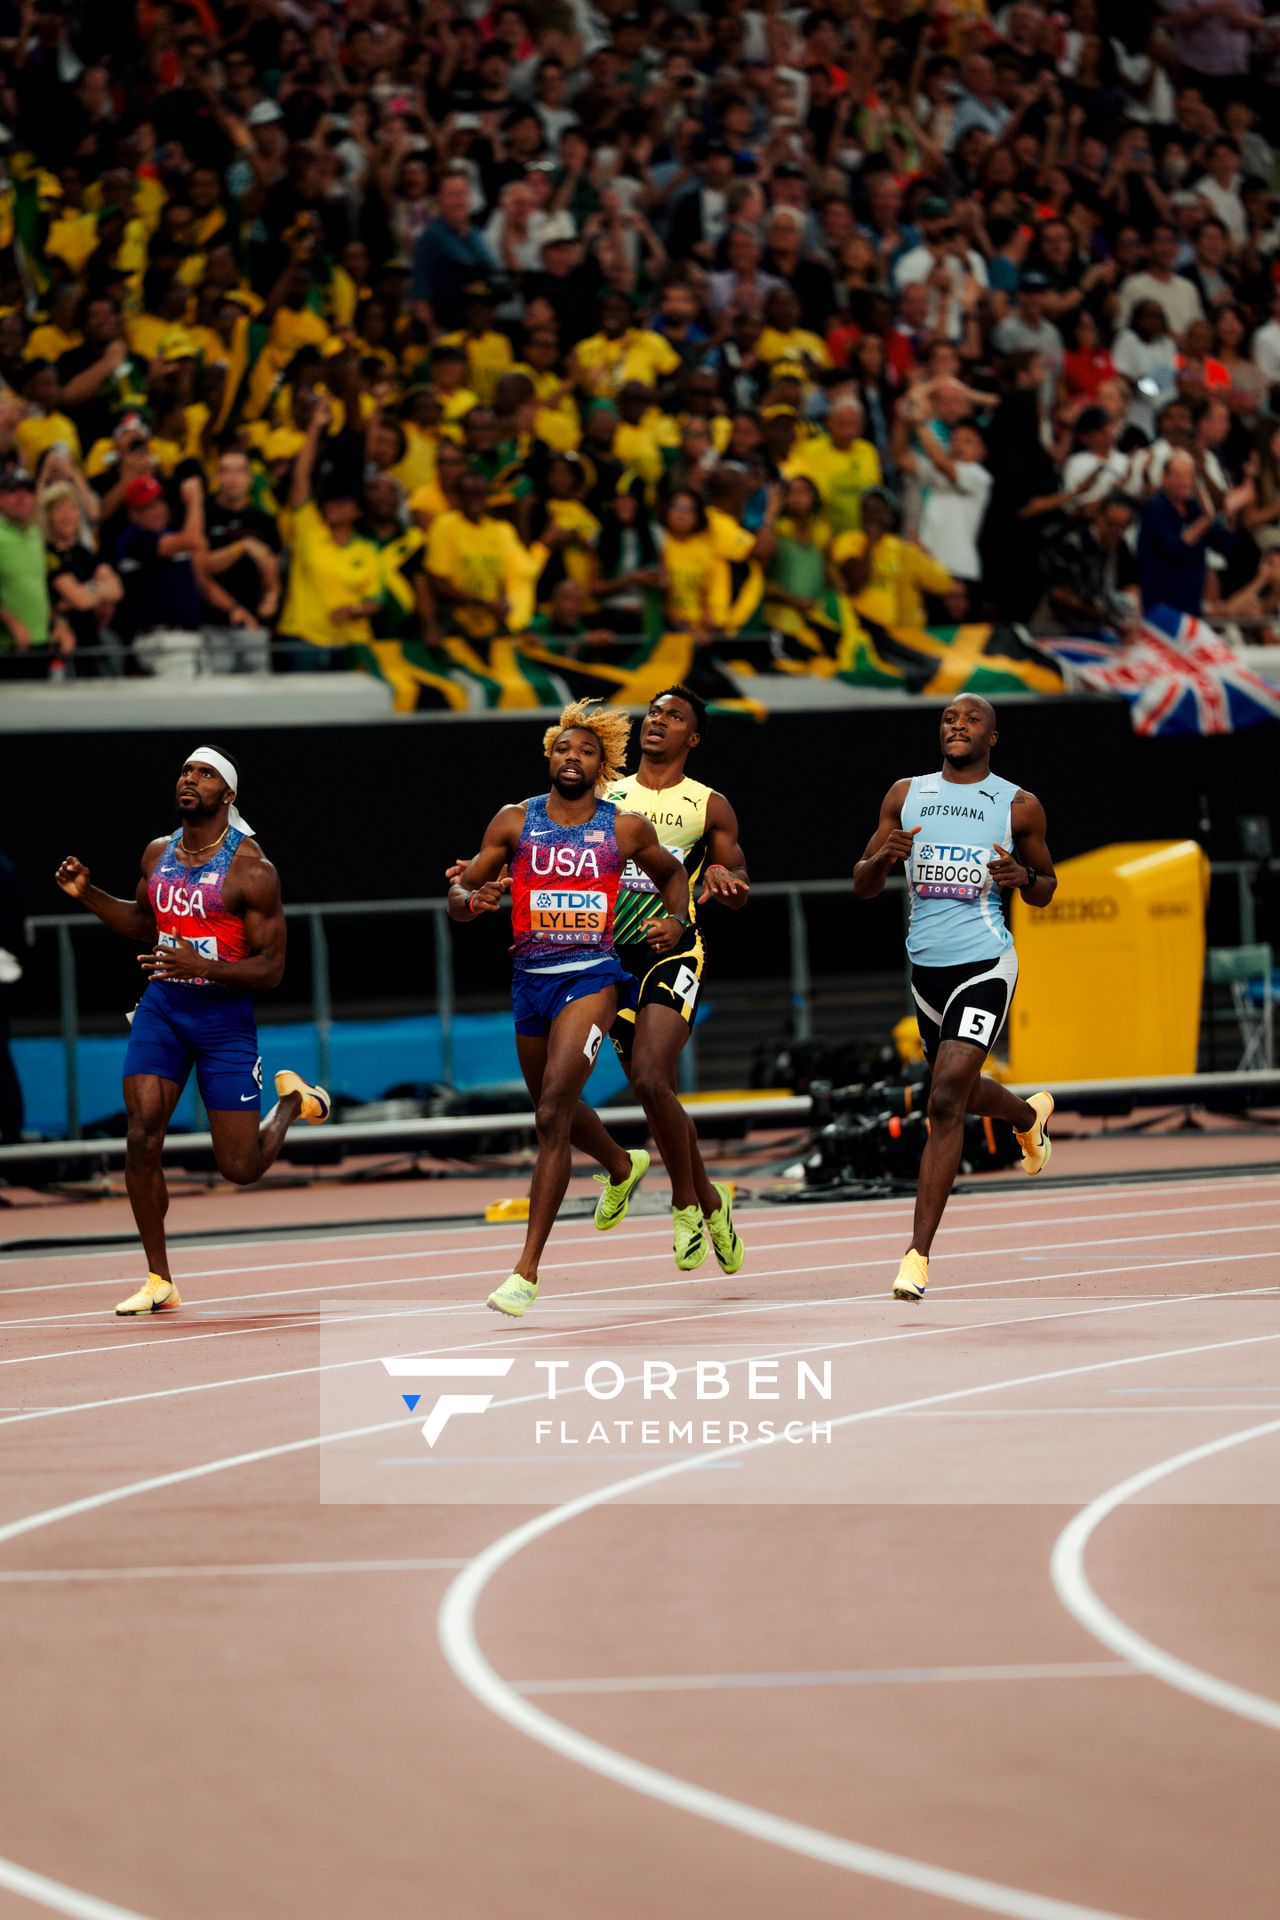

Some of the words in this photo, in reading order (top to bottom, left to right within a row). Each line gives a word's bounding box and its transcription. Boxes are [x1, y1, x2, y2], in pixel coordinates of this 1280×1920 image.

[643, 811, 683, 828] AICA
[920, 805, 985, 822] BOTSWANA
[531, 845, 599, 878] USA
[935, 845, 984, 865] TDK
[917, 864, 982, 884] TEBOGO
[156, 883, 207, 919] USA
[551, 893, 602, 909] TDK
[540, 912, 599, 928] LYLES
[169, 937, 211, 954] TK
[682, 974, 695, 994] 7
[970, 1013, 986, 1036] 5
[591, 1036, 601, 1056] 6
